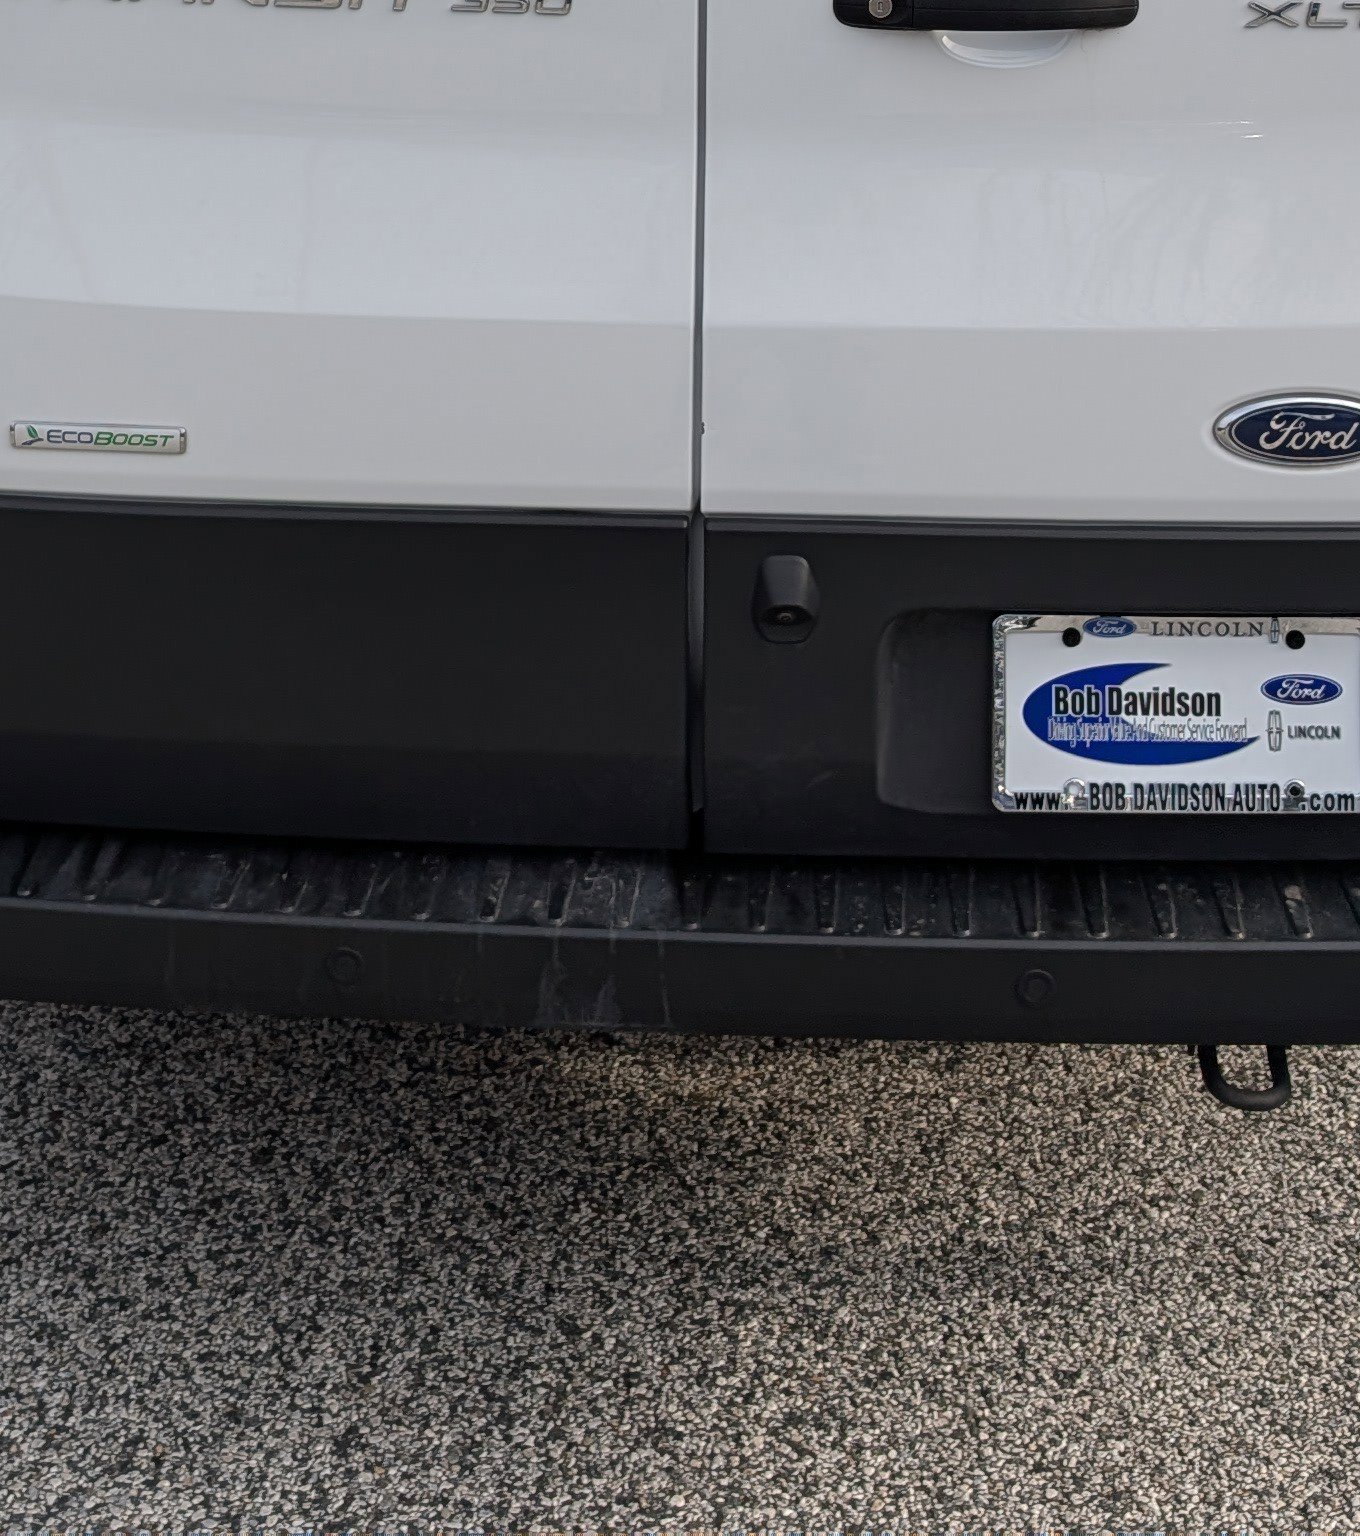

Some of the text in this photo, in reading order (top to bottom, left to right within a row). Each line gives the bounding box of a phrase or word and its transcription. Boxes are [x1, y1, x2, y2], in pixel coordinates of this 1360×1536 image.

[1259, 411, 1360, 451] Ford
[1092, 619, 1263, 637] Ford LINCOLN
[1053, 685, 1221, 717] Bob Davidson
[1276, 678, 1325, 699] Ford
[1047, 717, 1077, 748] Driving
[1076, 717, 1108, 748] Superior
[1150, 717, 1186, 742] Customer
[1187, 717, 1216, 742] Service
[1287, 725, 1341, 740] LINCOLN
[1090, 782, 1126, 811] BOB
[1133, 782, 1226, 811] DAVIDSON
[1233, 783, 1281, 811] AUTO
[1300, 792, 1355, 811] .com
